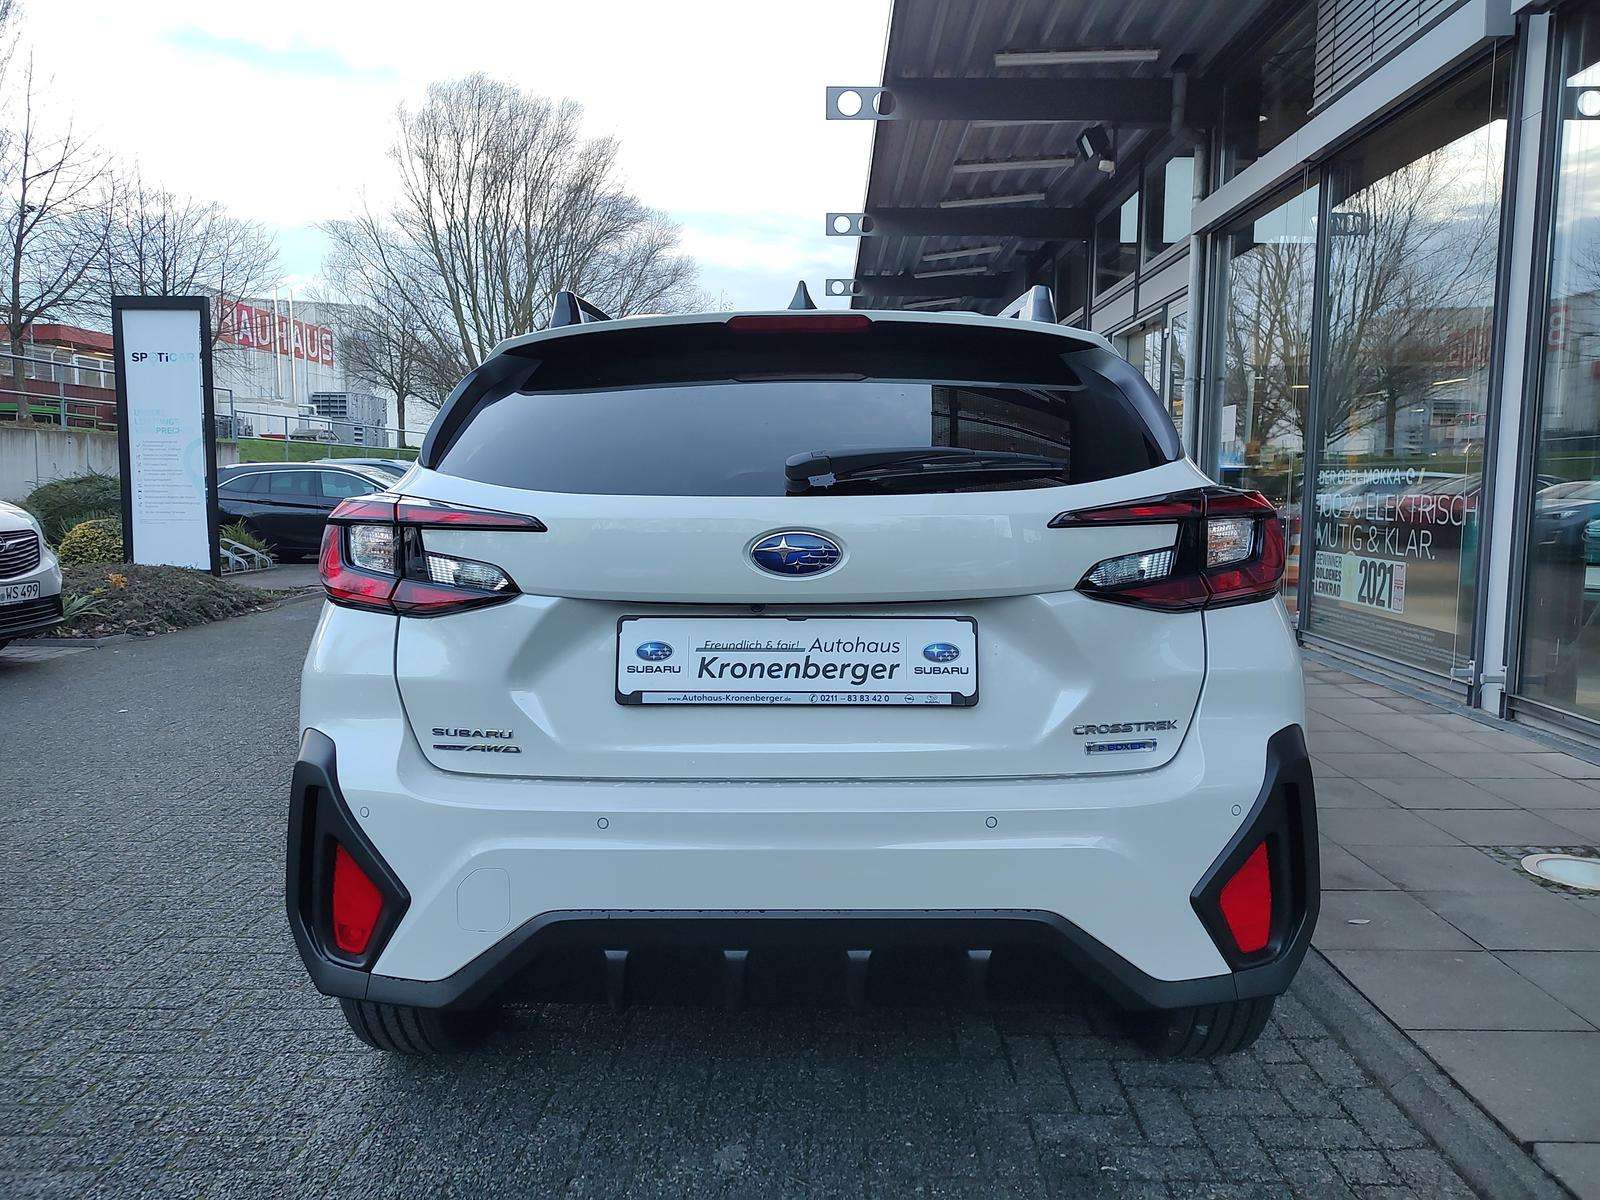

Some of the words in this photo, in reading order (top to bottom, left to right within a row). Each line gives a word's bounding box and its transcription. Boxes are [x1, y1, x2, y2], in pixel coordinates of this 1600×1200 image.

[220, 303, 333, 362] BAUHAUS
[1366, 493, 1479, 527] ELEKTRISCH
[1315, 522, 1362, 551] MUTIG
[1366, 525, 1380, 553] &
[1384, 527, 1436, 560] KLAR.
[21, 584, 38, 598] 499
[1358, 560, 1394, 609] 2021
[703, 640, 762, 650] Freundlich
[765, 640, 773, 650] &
[776, 640, 800, 650] fair!
[808, 636, 900, 653] Autohaus
[627, 665, 681, 673] SUBARU
[697, 655, 900, 686] Kronenberger
[914, 666, 969, 674] SUBARU
[667, 694, 792, 703] www.Autohaus-Kronenberger.de
[820, 694, 838, 702] 0211
[847, 694, 857, 702] 83
[860, 694, 870, 702] 83
[432, 728, 513, 739] SUBARU
[1073, 720, 1177, 735] CROSSTREK
